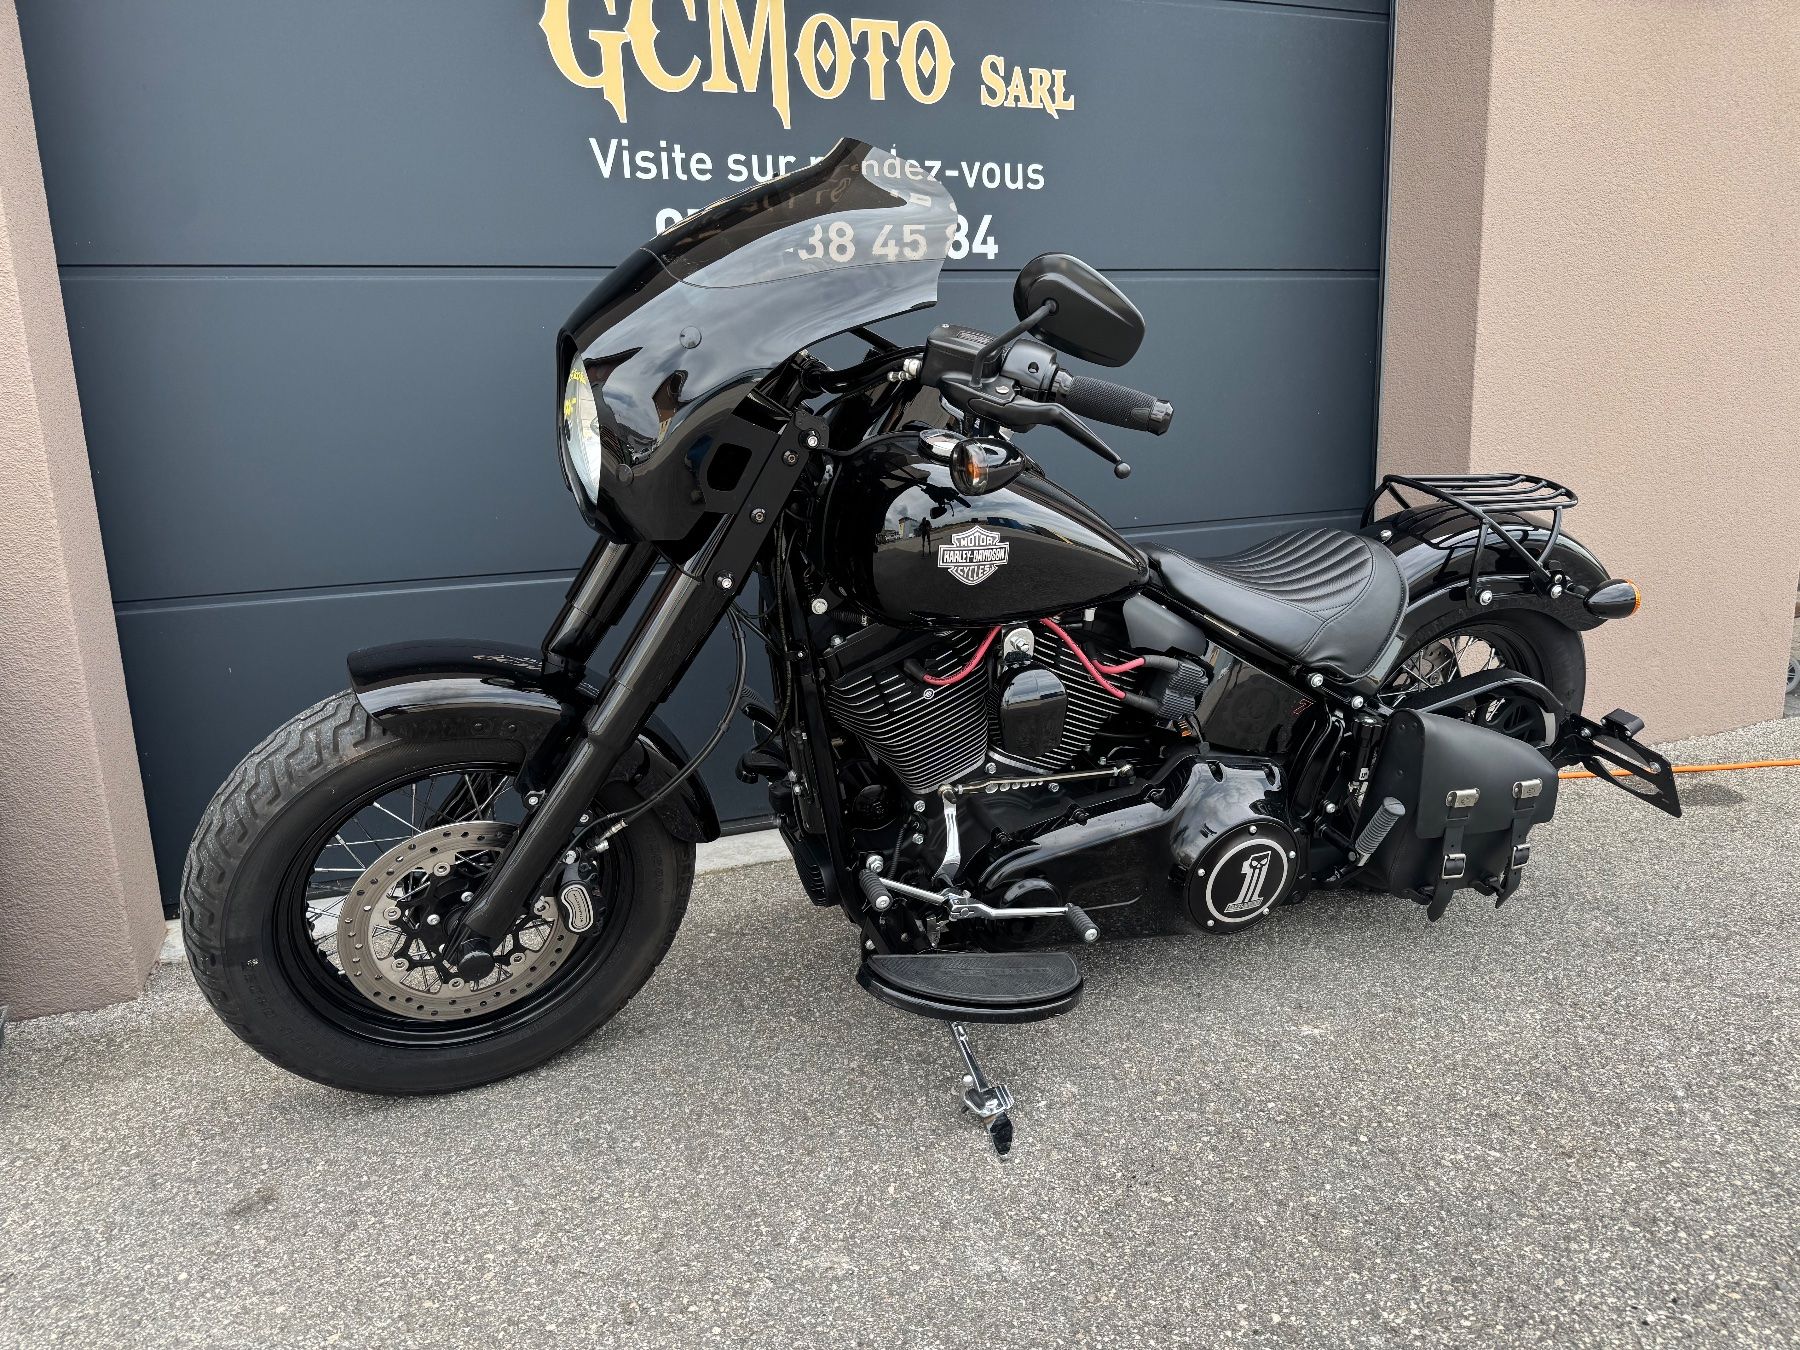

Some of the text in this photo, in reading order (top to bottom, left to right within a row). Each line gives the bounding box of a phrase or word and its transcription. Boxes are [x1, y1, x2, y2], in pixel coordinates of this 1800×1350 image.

[588, 137, 1045, 190] Visite sur ndez-vous
[872, 224, 927, 261] 45
[945, 214, 999, 260] 84
[960, 532, 993, 546] MOTOR
[943, 548, 1005, 562] HARLEY-DAVIDSON
[957, 565, 990, 580] CYCLES
